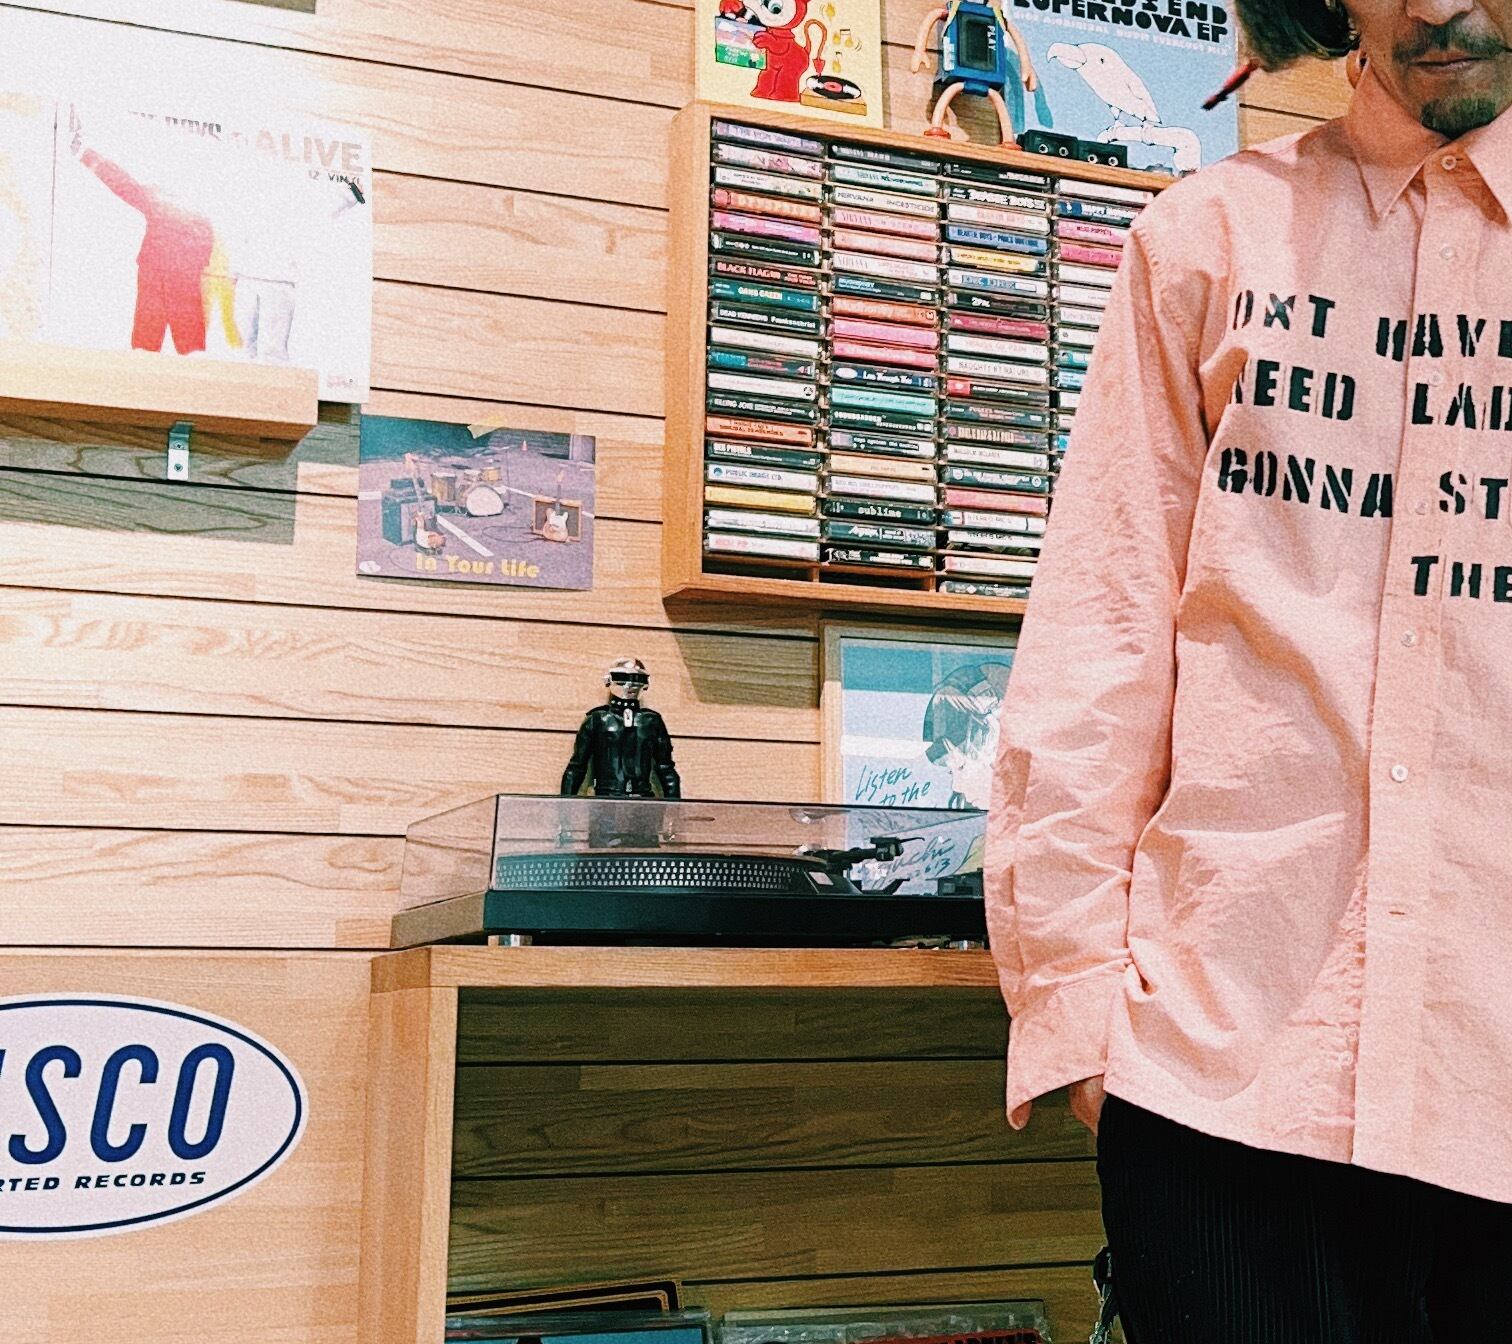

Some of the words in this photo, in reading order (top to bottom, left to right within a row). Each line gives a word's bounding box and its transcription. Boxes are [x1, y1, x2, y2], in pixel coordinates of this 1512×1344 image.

[1197, 24, 1228, 43] EP
[255, 127, 365, 174] ALIVE
[1218, 447, 1394, 519] GONNA
[857, 505, 902, 519] sublime
[447, 554, 496, 575] Your
[855, 765, 913, 803] Listen
[902, 781, 931, 804] the
[0, 1042, 236, 1165] SCO
[73, 1171, 207, 1190] RECORDS
